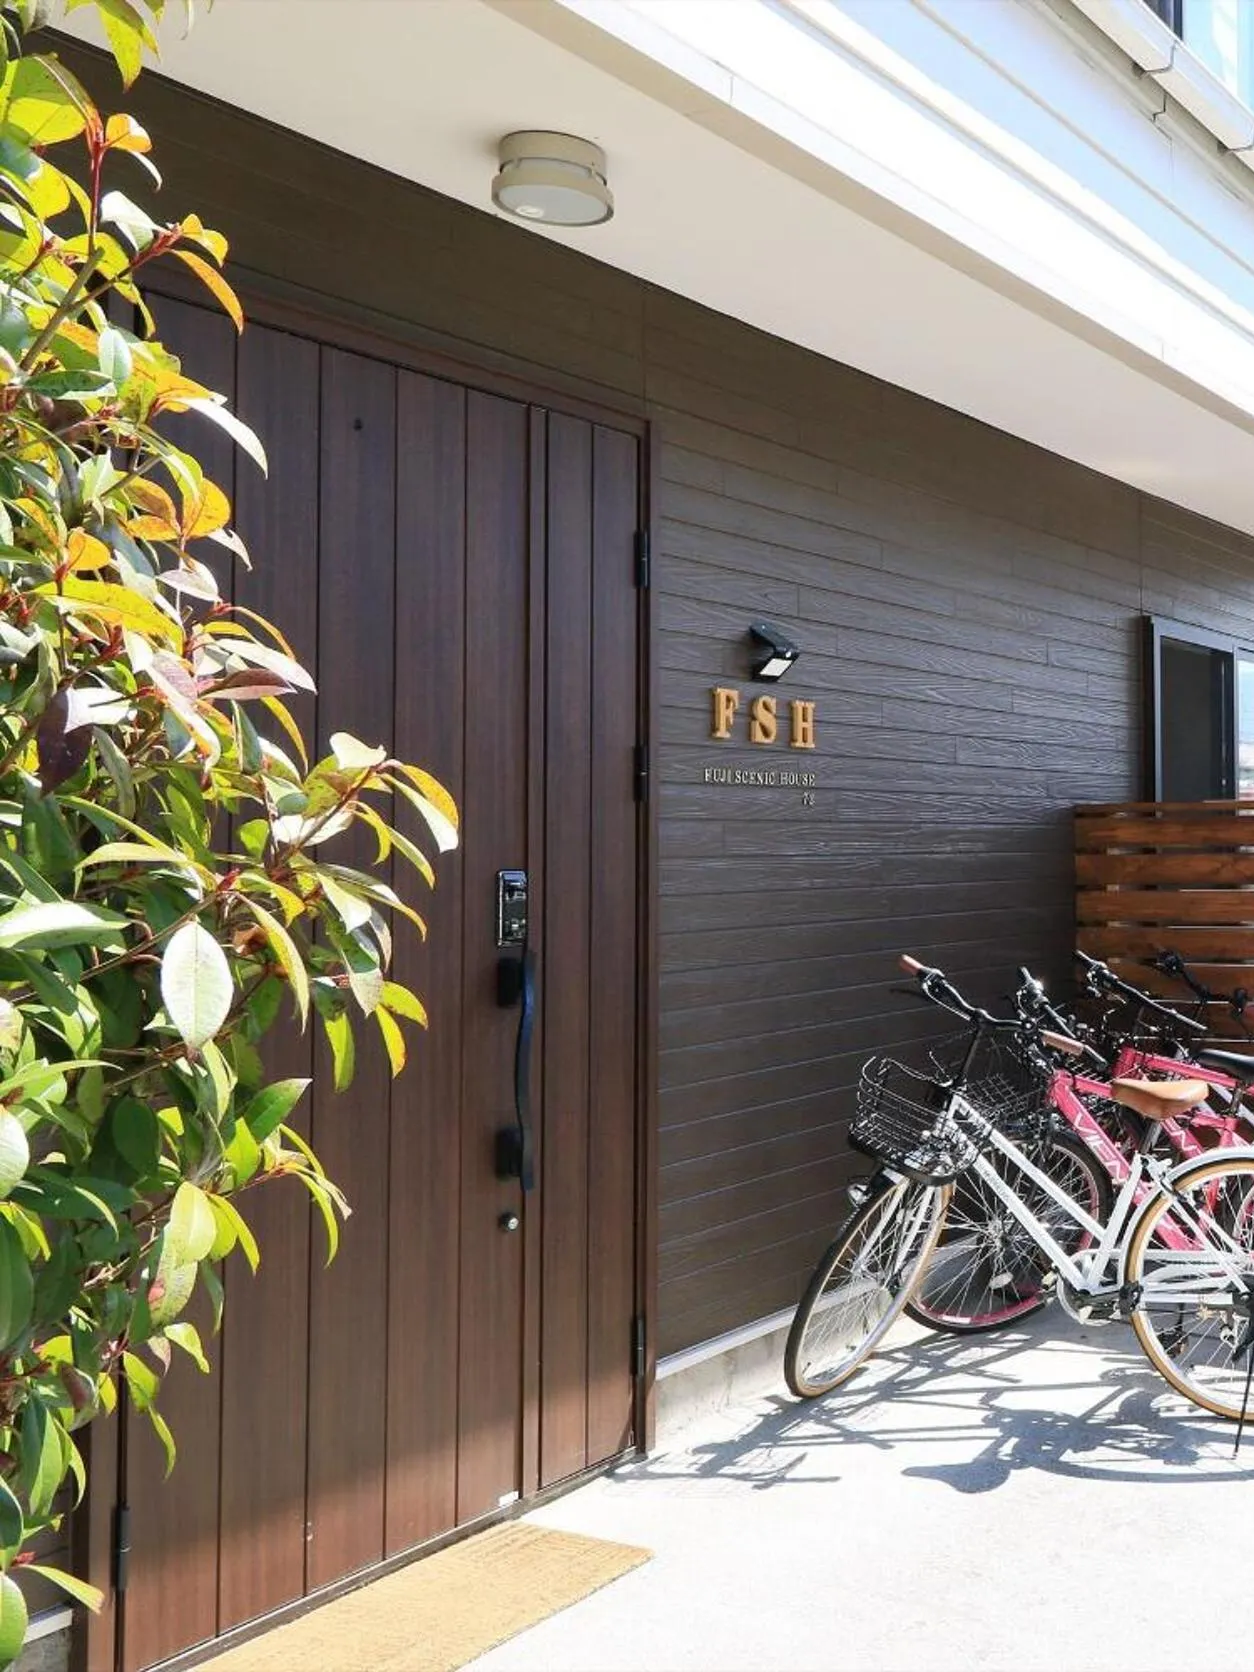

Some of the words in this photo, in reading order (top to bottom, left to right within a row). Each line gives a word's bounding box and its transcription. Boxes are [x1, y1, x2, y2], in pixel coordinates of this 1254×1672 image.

[711, 686, 817, 749] FSH
[703, 768, 732, 784] FUJI
[735, 769, 776, 786] SCENIC
[780, 772, 816, 788] HOUSE
